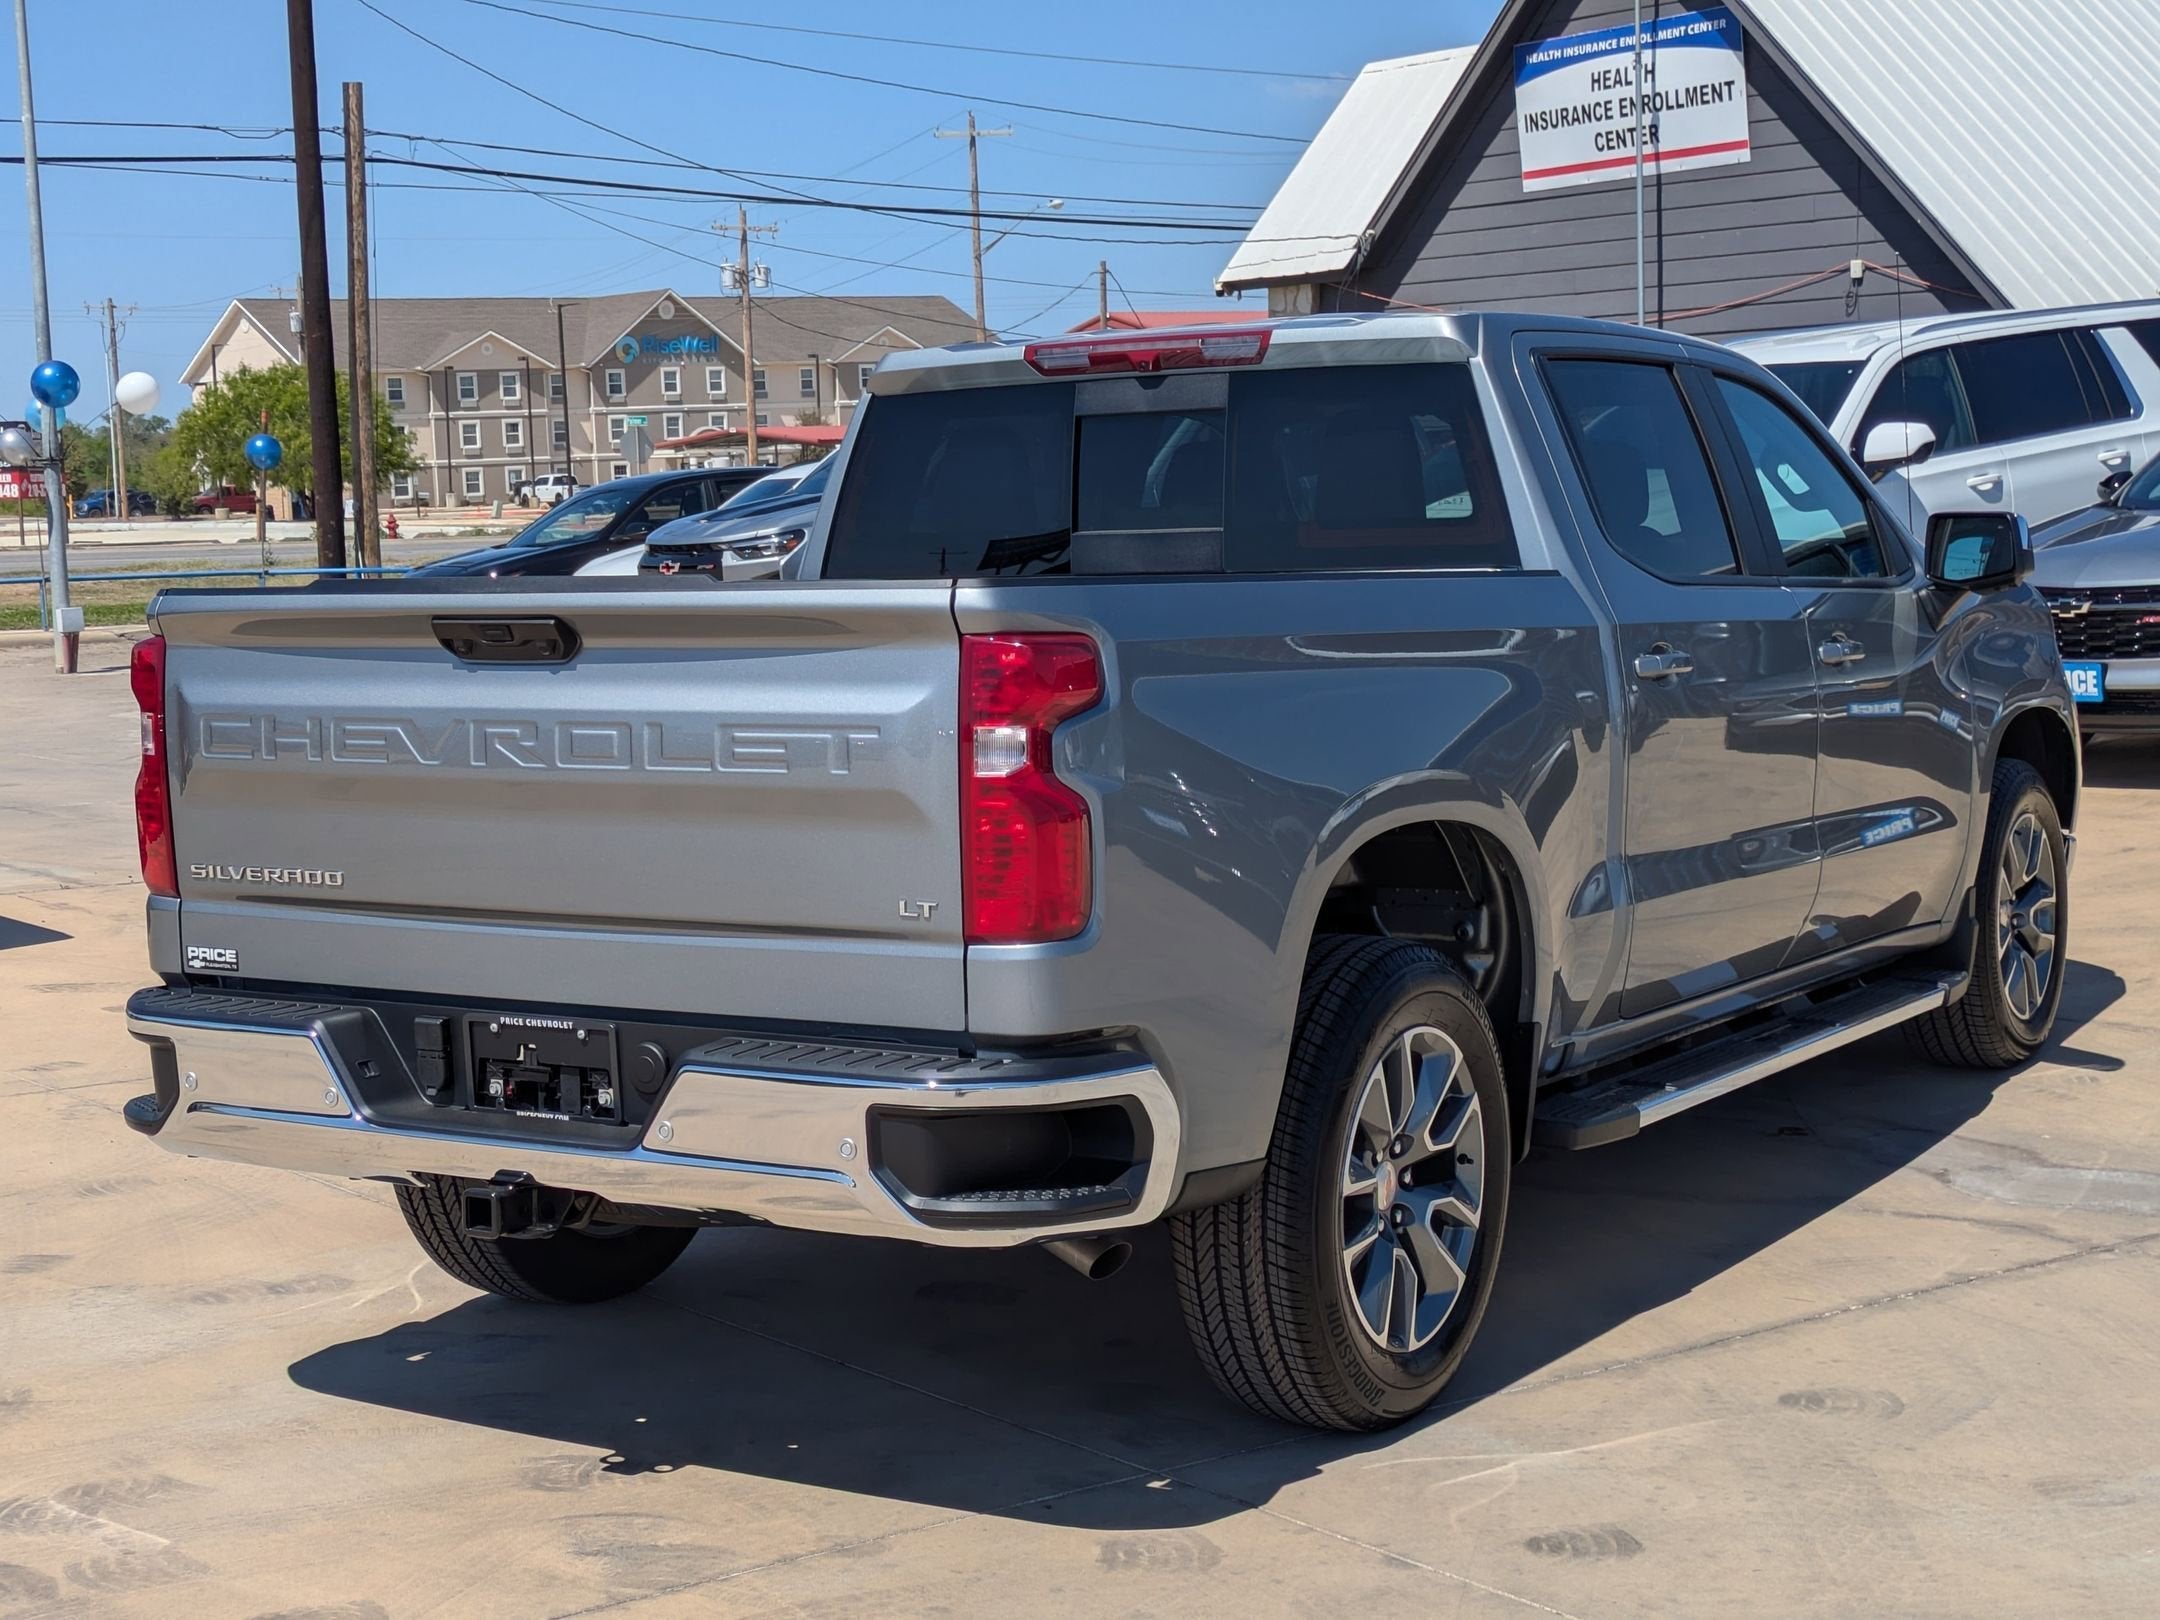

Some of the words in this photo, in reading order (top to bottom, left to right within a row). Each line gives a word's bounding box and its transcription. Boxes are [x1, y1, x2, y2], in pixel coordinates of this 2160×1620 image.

[1526, 50, 1562, 65] HEALTH
[1564, 41, 1618, 58] INSURANCE
[1688, 18, 1727, 36] CENTER
[1591, 62, 1656, 93] HEALH
[1524, 100, 1614, 133] INSURANCE
[1619, 80, 1736, 118] ENROLLMENT
[1594, 124, 1660, 152] CENTER
[642, 335, 720, 354] RiseWell
[2064, 669, 2098, 693] ICE
[201, 712, 881, 775] CHEVROLET
[190, 864, 345, 886] SILVERADO
[899, 899, 939, 920] LT
[187, 946, 237, 962] PRICE
[500, 1017, 524, 1027] PRICE
[525, 1018, 573, 1030] CHEVROLET
[1326, 1302, 1386, 1406] BRIDGESTONE
